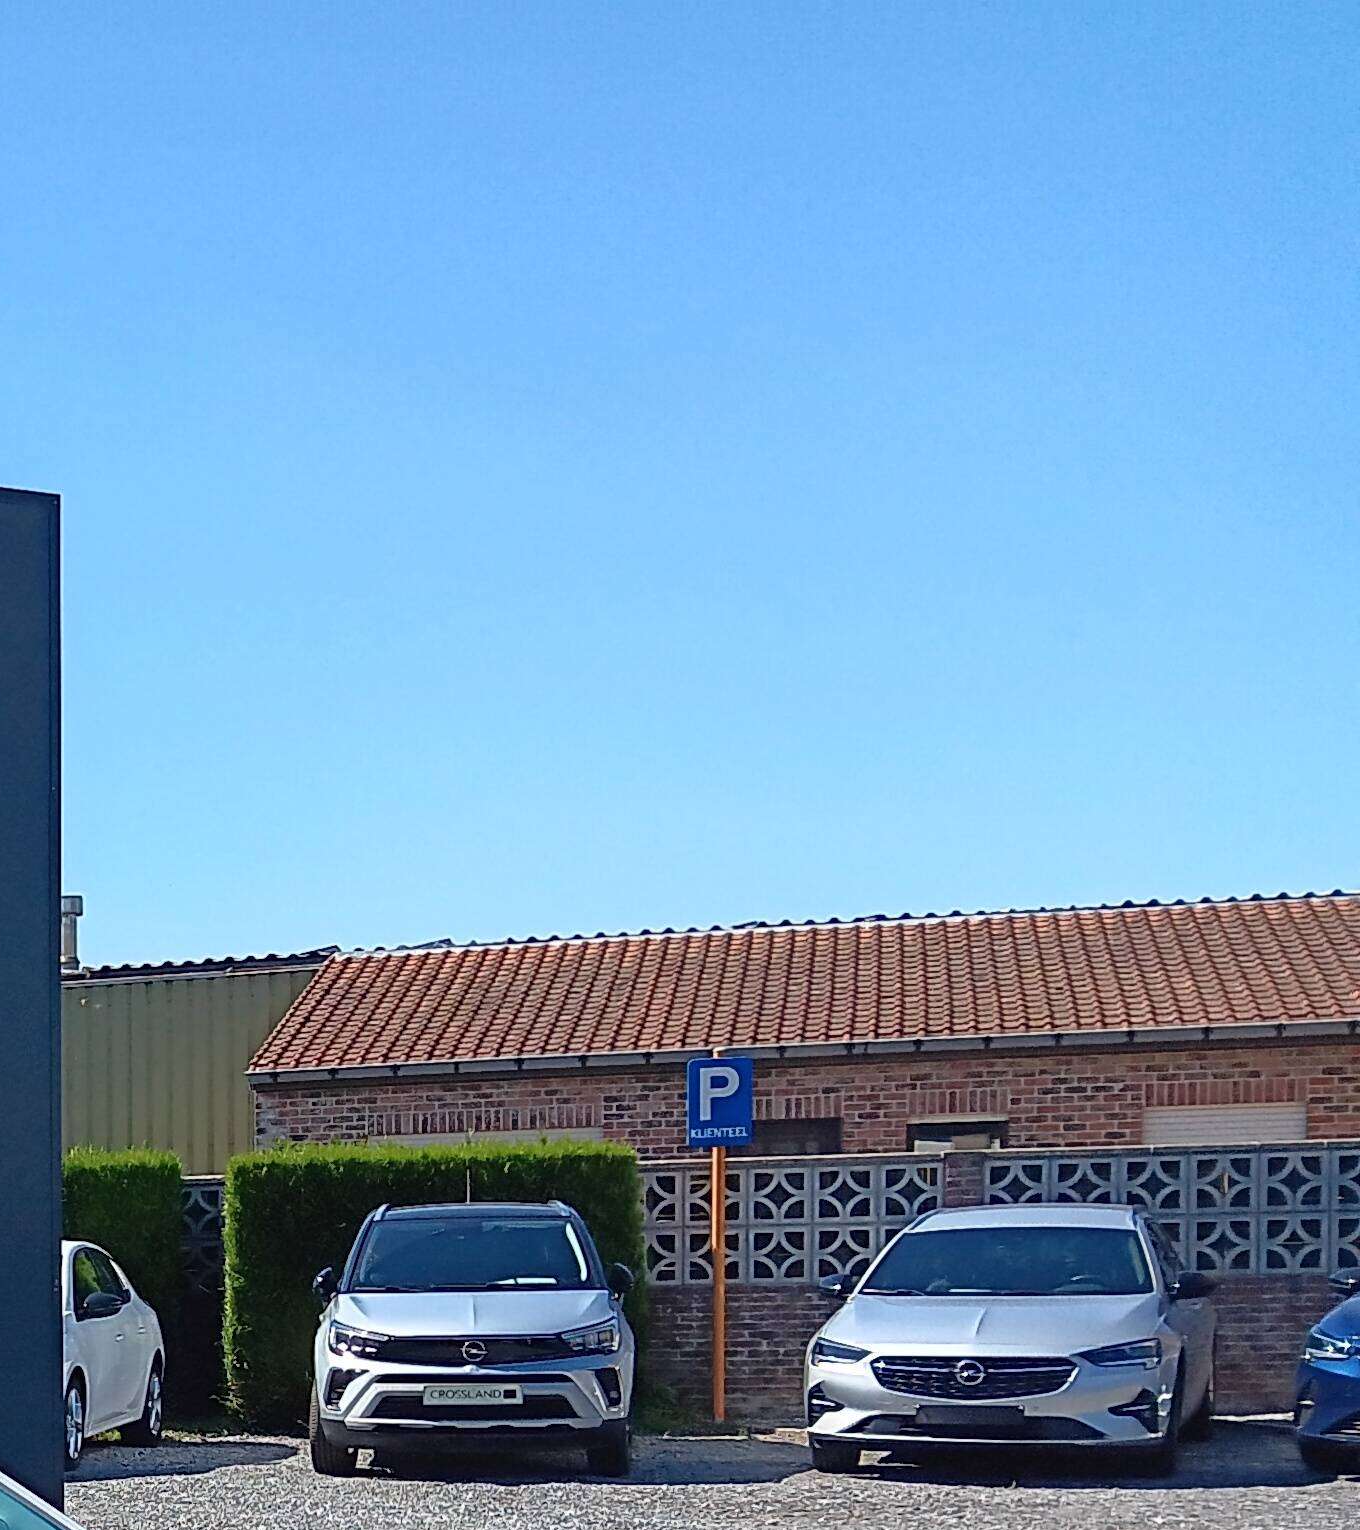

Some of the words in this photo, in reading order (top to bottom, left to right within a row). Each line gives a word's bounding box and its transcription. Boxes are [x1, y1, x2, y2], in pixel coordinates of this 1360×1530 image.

[700, 1067, 740, 1121] P
[691, 1126, 749, 1139] KLIENTEEL
[430, 1389, 502, 1400] CROSSLAND
